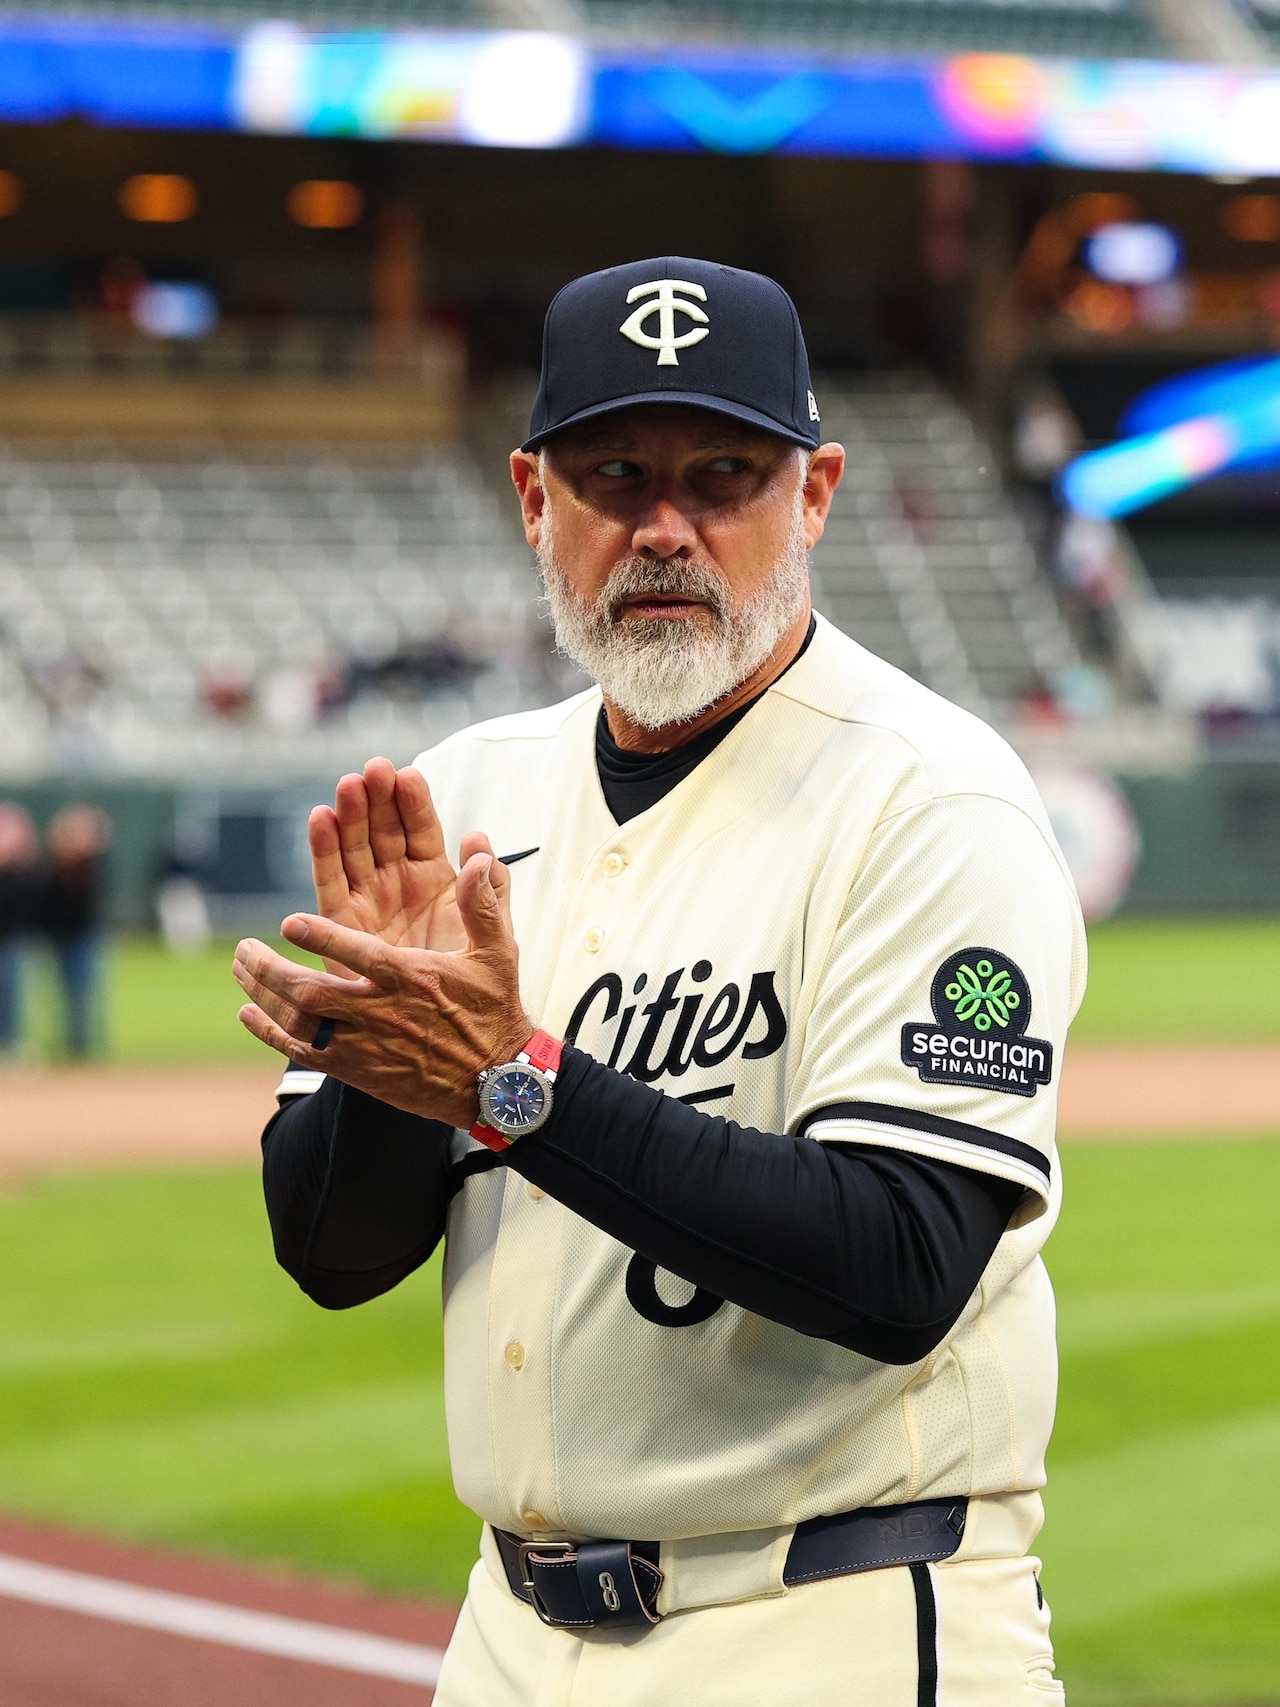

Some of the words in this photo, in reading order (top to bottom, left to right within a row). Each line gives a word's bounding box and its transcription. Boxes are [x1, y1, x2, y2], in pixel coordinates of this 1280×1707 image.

[563, 959, 788, 1083] Cities
[912, 1032, 1045, 1072] securian
[931, 1057, 1029, 1084] FINANCIAL
[598, 1571, 621, 1611] 8
